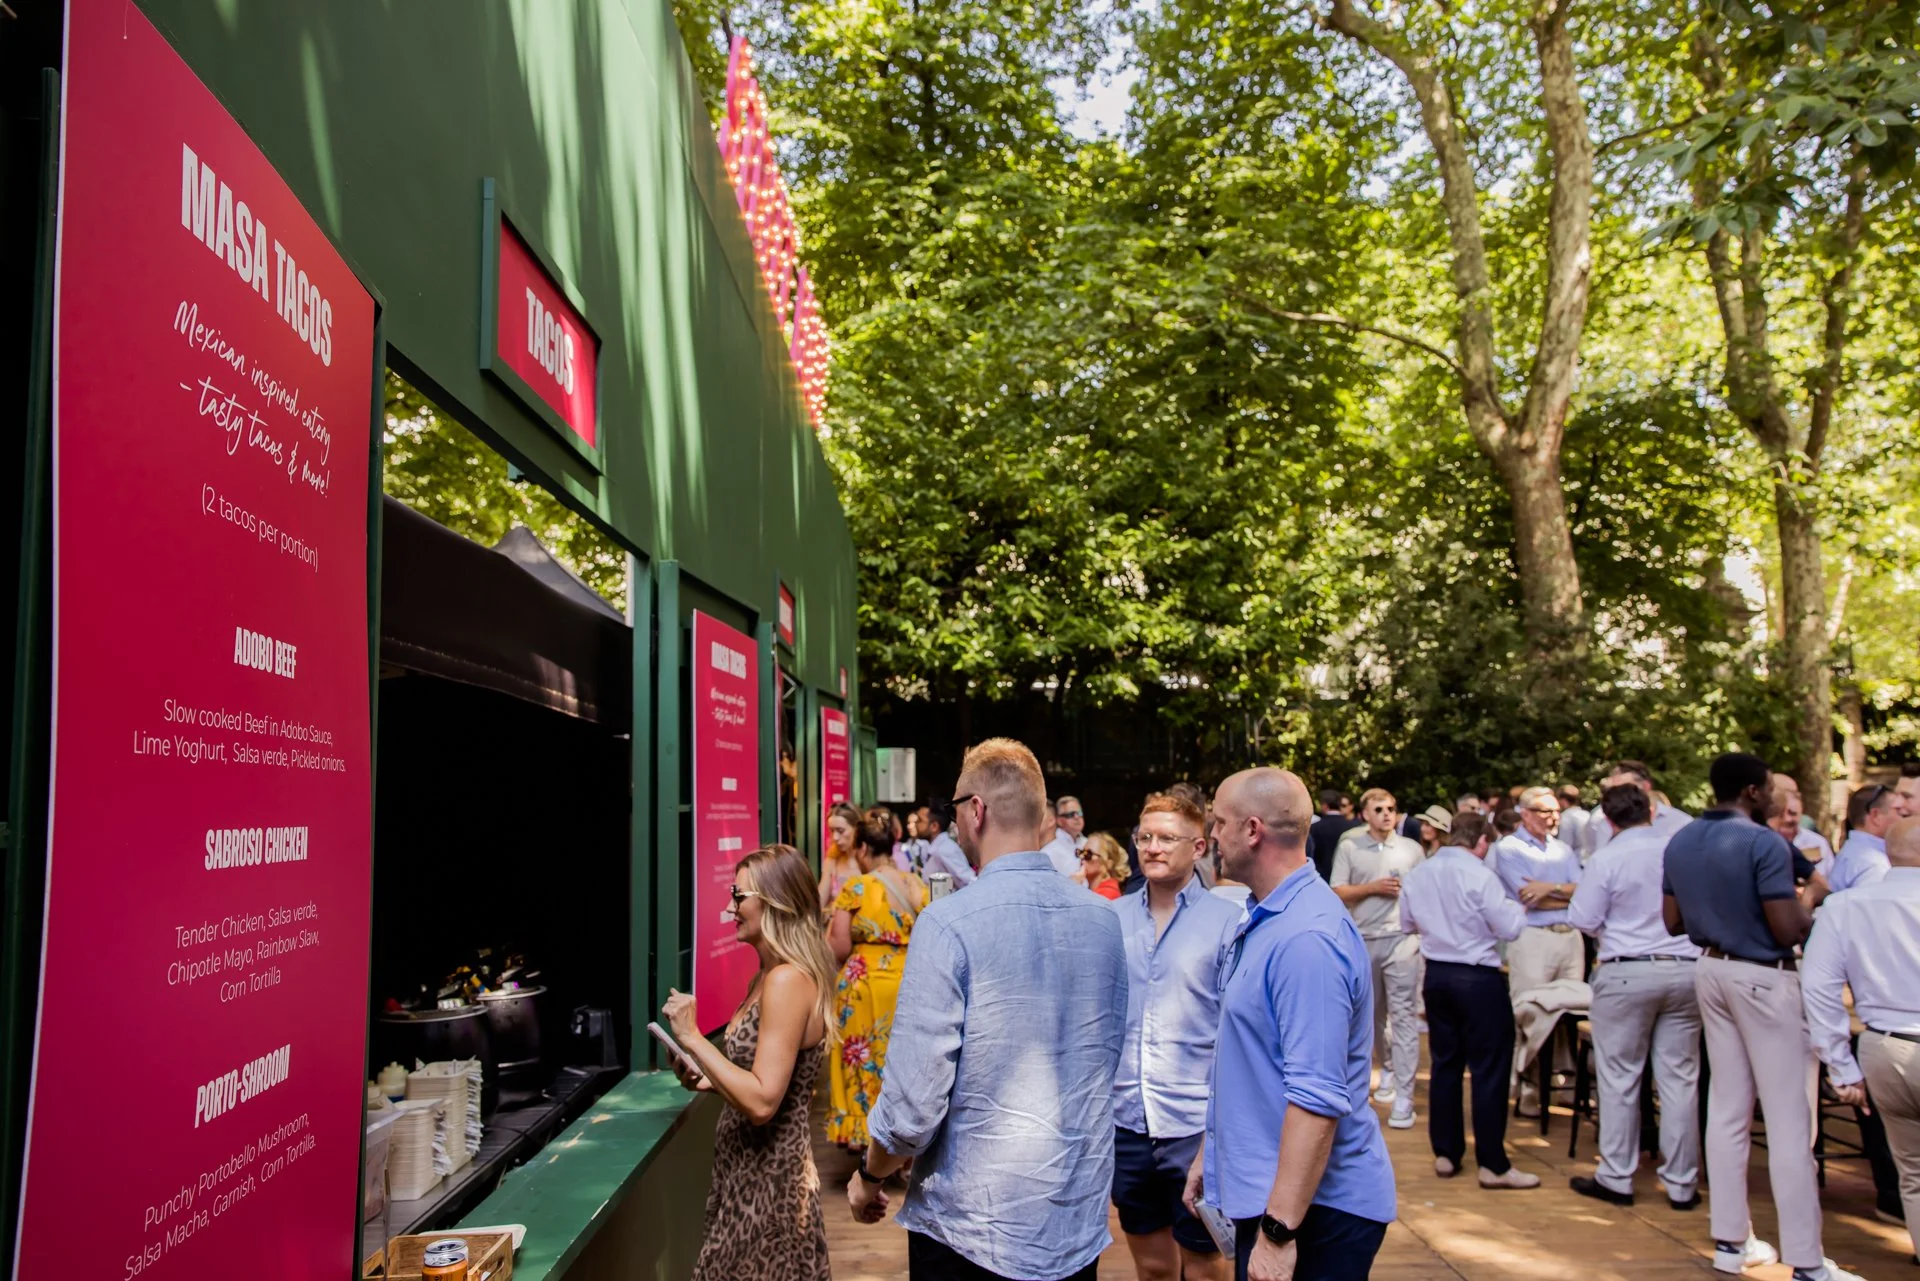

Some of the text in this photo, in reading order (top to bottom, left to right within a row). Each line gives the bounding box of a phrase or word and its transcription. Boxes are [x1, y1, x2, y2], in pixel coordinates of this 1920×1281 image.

[182, 142, 333, 368] MASA TACOS
[173, 300, 331, 466] Mexican inspired eatery
[526, 286, 574, 396] TACOS
[247, 409, 283, 466] tacos
[287, 440, 299, 485] &
[301, 459, 331, 500] more!
[201, 482, 319, 573] (2 tacos per portion)
[233, 626, 298, 680] ADOBO BEEF
[133, 730, 346, 773] Lime Yoghurt, Salsa verde, Pickled onions.
[163, 698, 333, 747] Slow cooked Beef in Adobo Sauce,
[204, 825, 309, 871] SABROSO CHICKEN
[167, 929, 320, 986] Chipotle Mayo, Rainbow Slaw,
[174, 899, 318, 949] Tender Chicken, Salsa verde,
[219, 965, 282, 1003] Corn Tortilla
[193, 1043, 291, 1129] PORTO-SHROOM
[123, 1132, 317, 1281] Salsa Macha, Garnish, Corn Tortilla.
[143, 1111, 310, 1233] Punchy Portobello Mushroom,
